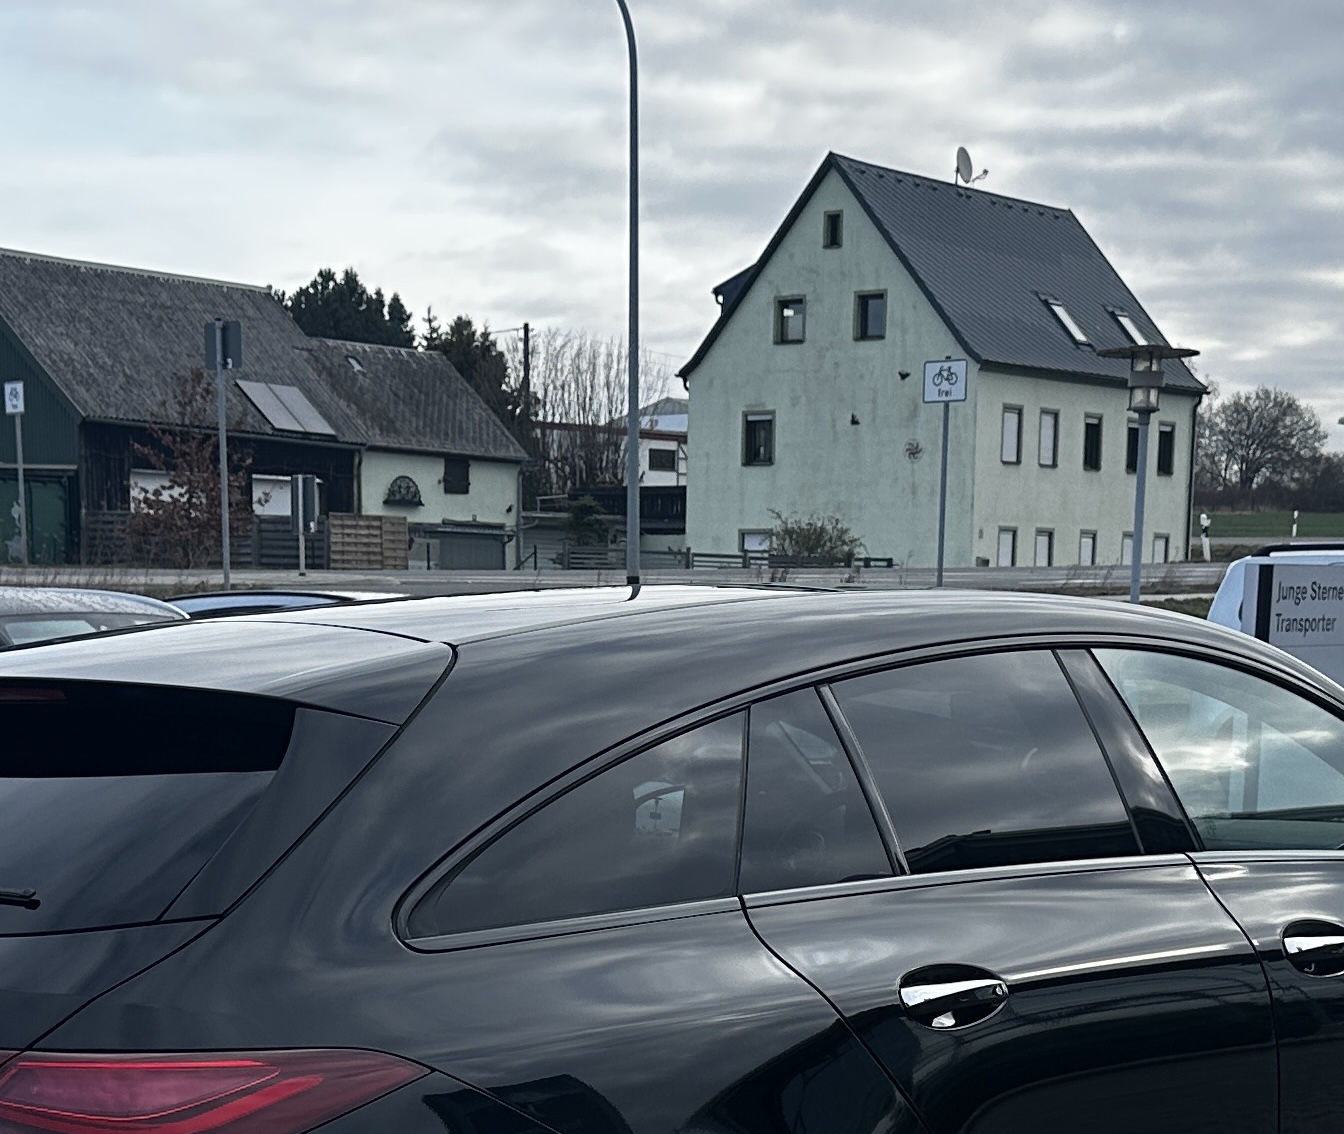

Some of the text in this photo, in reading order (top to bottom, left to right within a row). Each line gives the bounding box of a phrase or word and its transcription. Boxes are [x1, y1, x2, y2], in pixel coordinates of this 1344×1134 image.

[938, 388, 952, 397] frei
[1276, 581, 1344, 606] Junge Sterne
[1275, 613, 1337, 637] Transporter
